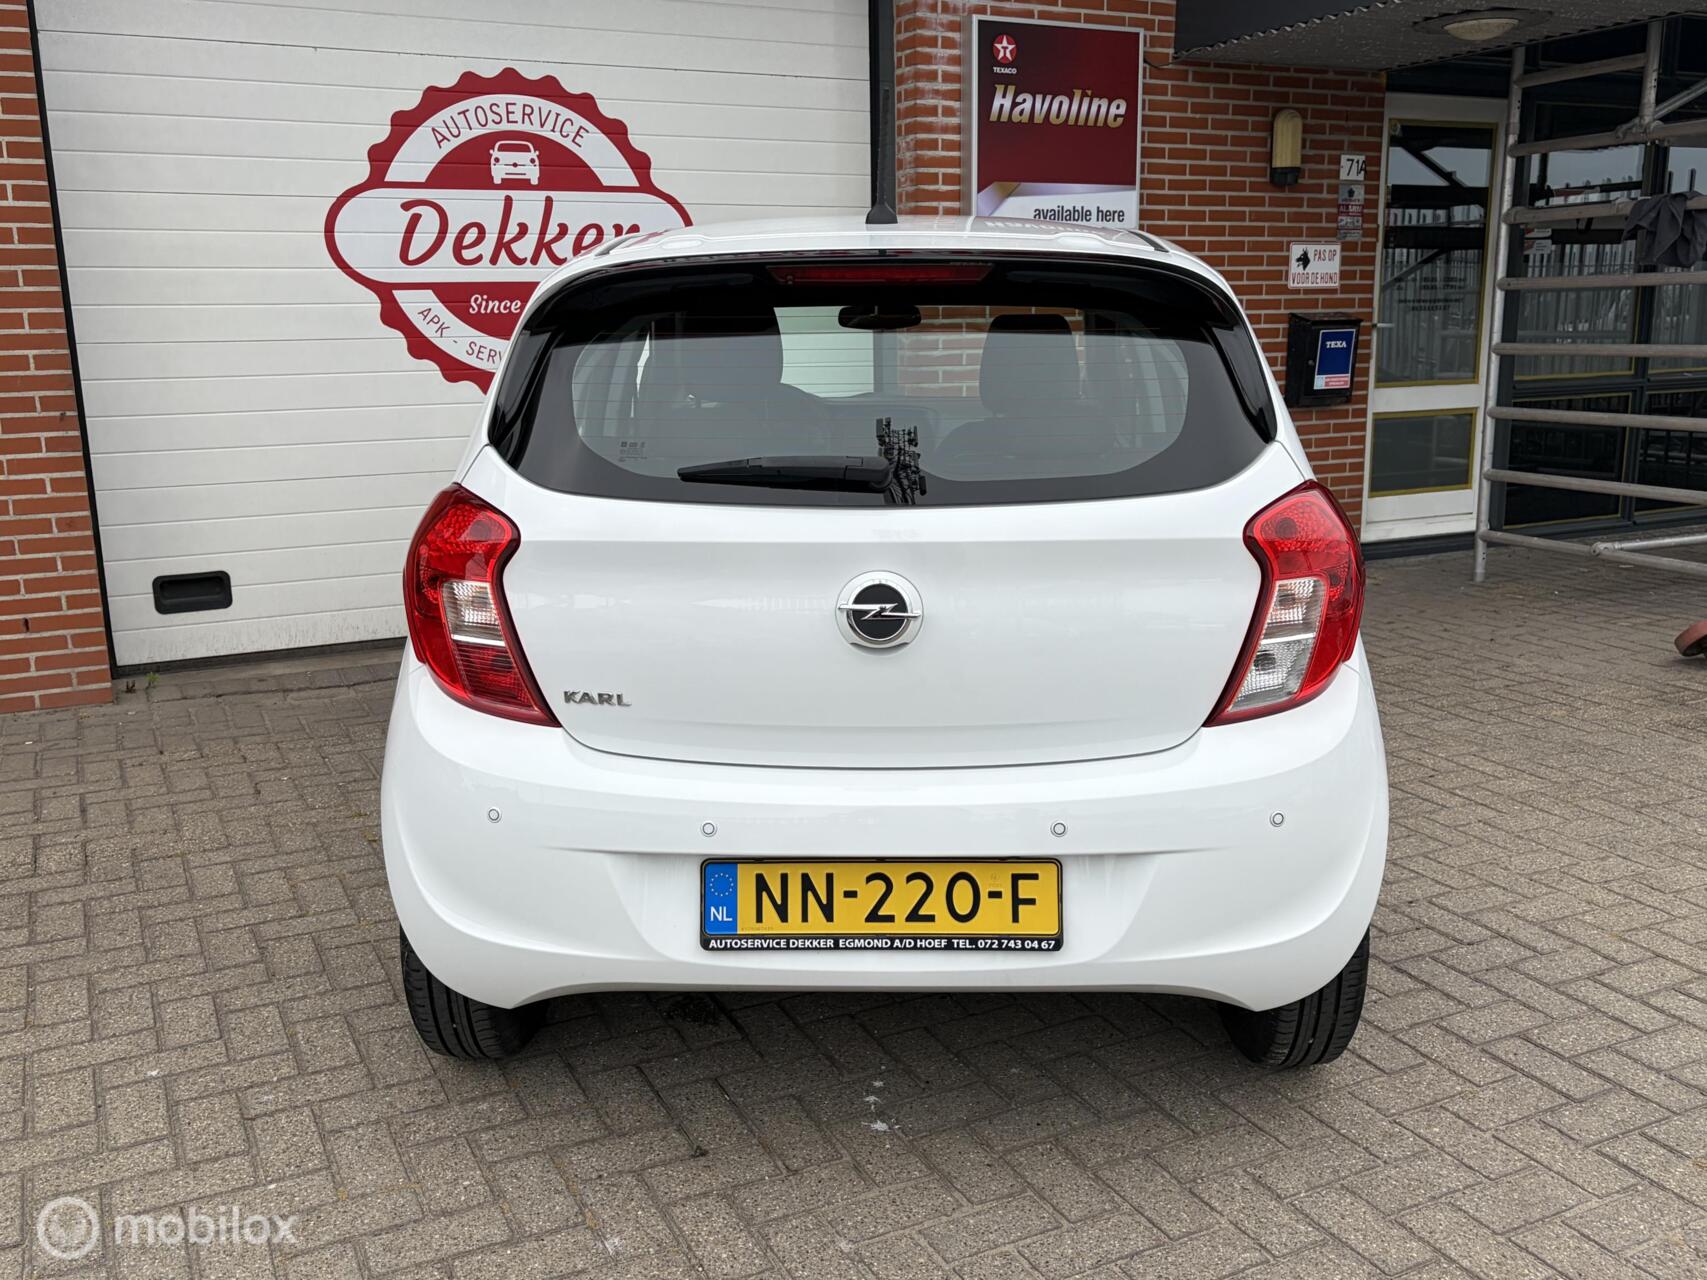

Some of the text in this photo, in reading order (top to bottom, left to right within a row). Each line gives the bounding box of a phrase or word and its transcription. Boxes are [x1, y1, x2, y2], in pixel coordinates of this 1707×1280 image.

[992, 66, 1017, 74] TEXACO
[989, 83, 1127, 128] Havoline
[430, 102, 590, 149] AUTOSERVICE
[1033, 205, 1125, 223] available here
[1313, 248, 1337, 262] PAS OP
[1291, 271, 1338, 285] VOOR DE HOND
[469, 293, 521, 314] Since
[418, 307, 450, 338] APK
[1325, 340, 1347, 349] TEXA
[563, 690, 632, 707] KARL
[755, 871, 1039, 924] NN-220-F
[710, 906, 732, 922] NL
[709, 938, 1056, 950] AUTOSERVICE DEKKER EGMOND A/D HOEF TEL. 072 743 04 67
